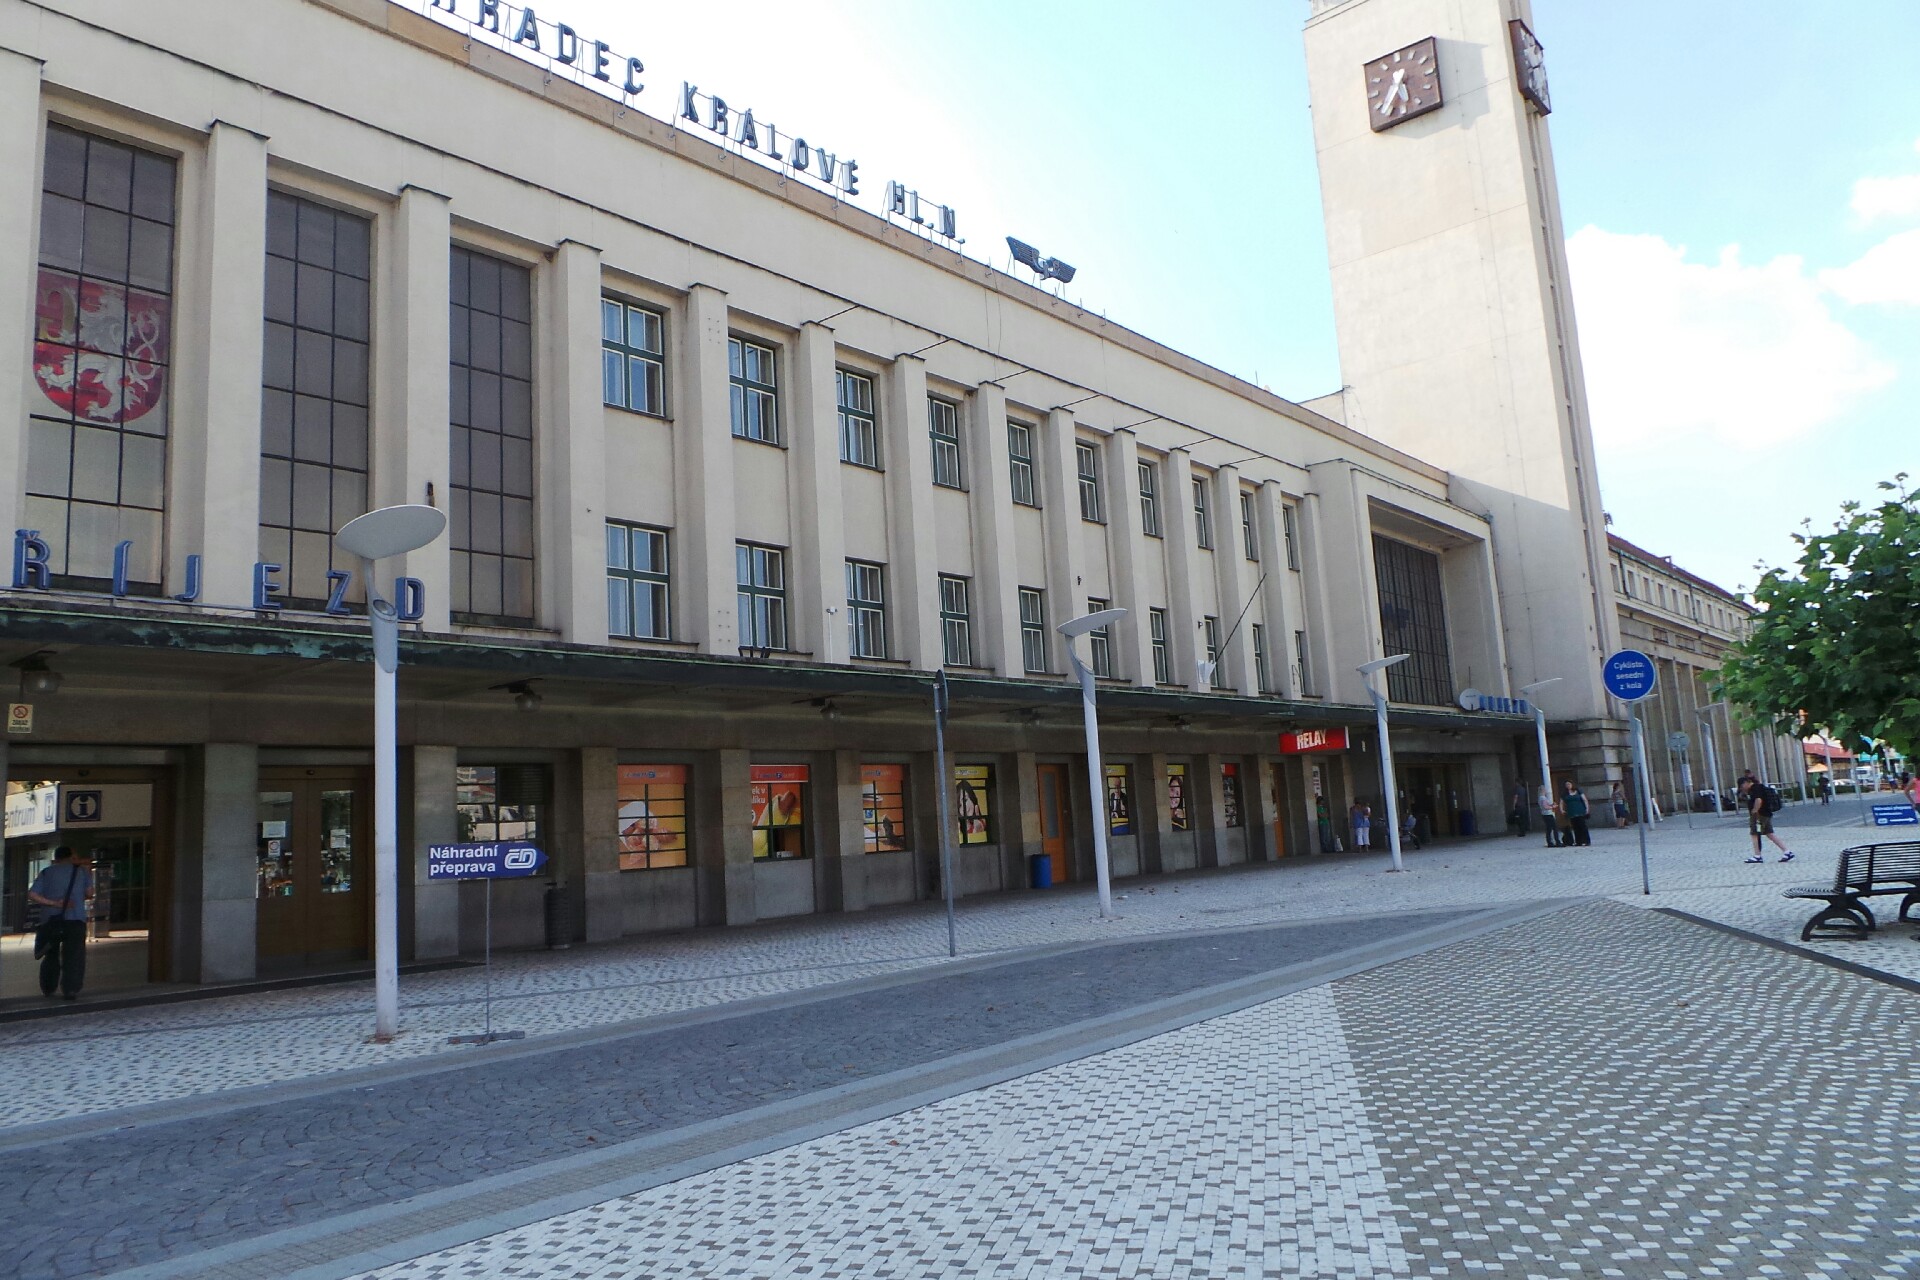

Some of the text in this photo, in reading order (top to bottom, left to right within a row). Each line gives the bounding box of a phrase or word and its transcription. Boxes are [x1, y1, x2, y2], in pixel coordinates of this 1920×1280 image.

[12, 528, 425, 620] ŘÍJEZD
[1296, 729, 1327, 750] RELAY
[430, 845, 499, 859] Náhradní
[430, 861, 496, 876] přeprava
